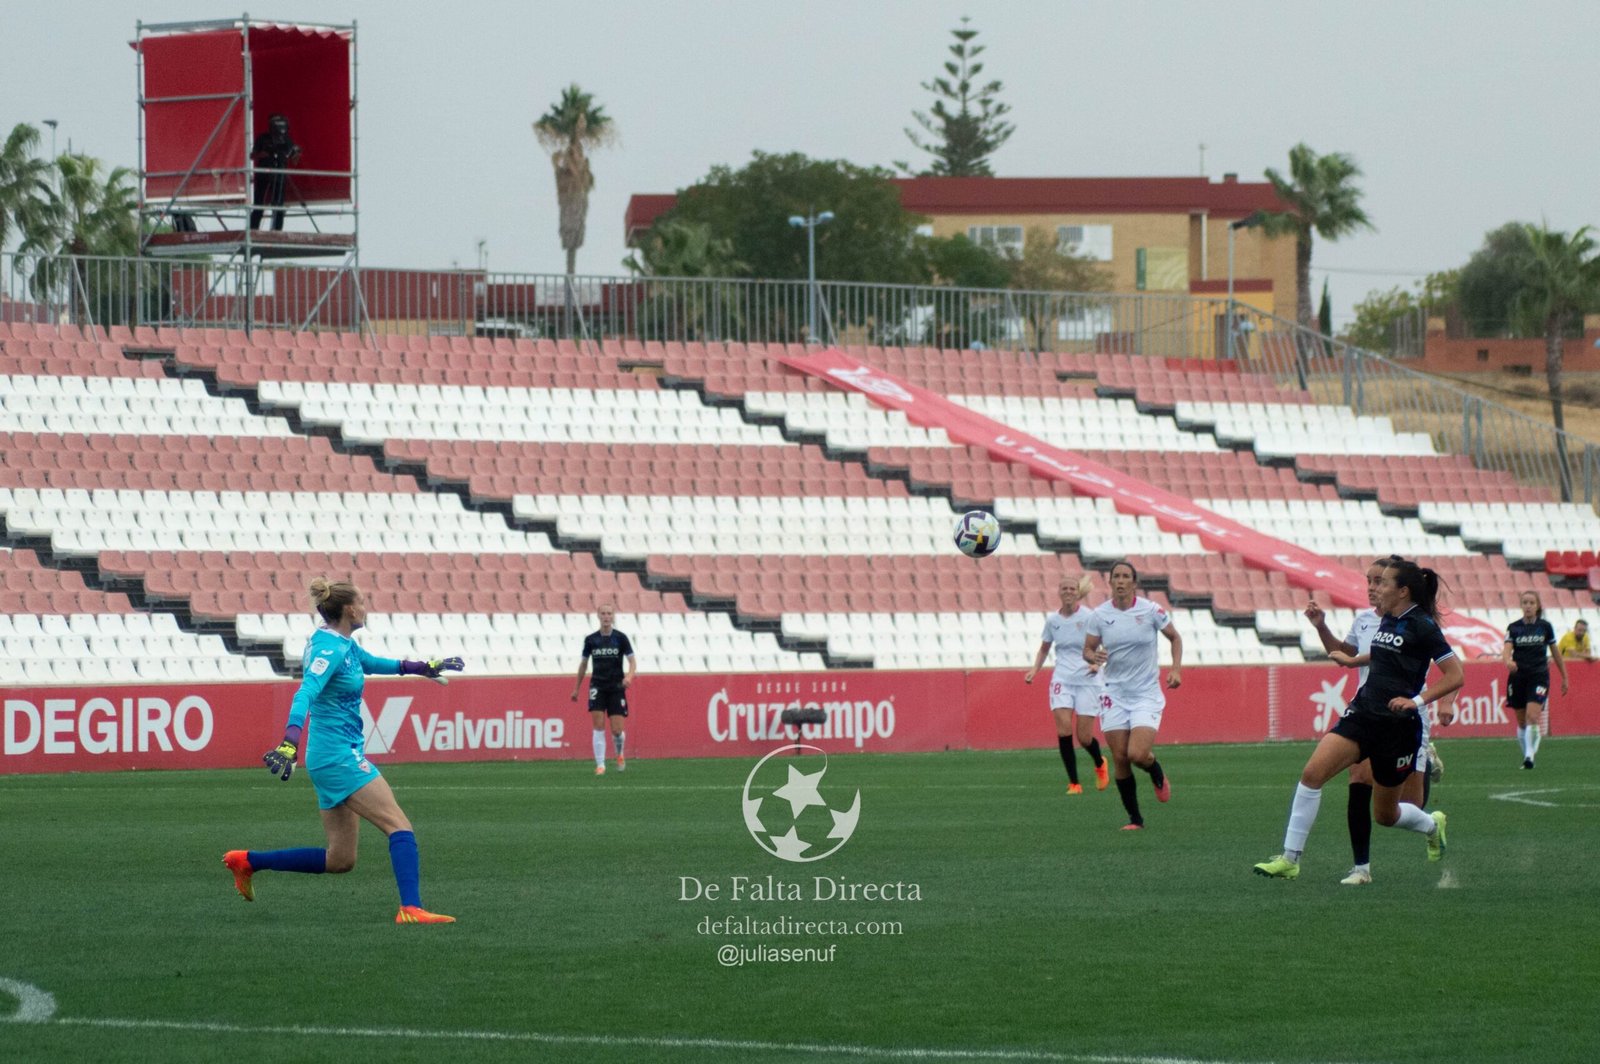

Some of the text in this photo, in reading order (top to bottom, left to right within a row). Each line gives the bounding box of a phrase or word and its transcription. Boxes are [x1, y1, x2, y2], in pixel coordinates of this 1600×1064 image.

[1373, 631, 1404, 647] AZOO
[4, 695, 214, 755] DEGIRO
[410, 710, 565, 752] Valvoline
[707, 688, 895, 748] Cruzcampo
[1396, 753, 1414, 769] DV
